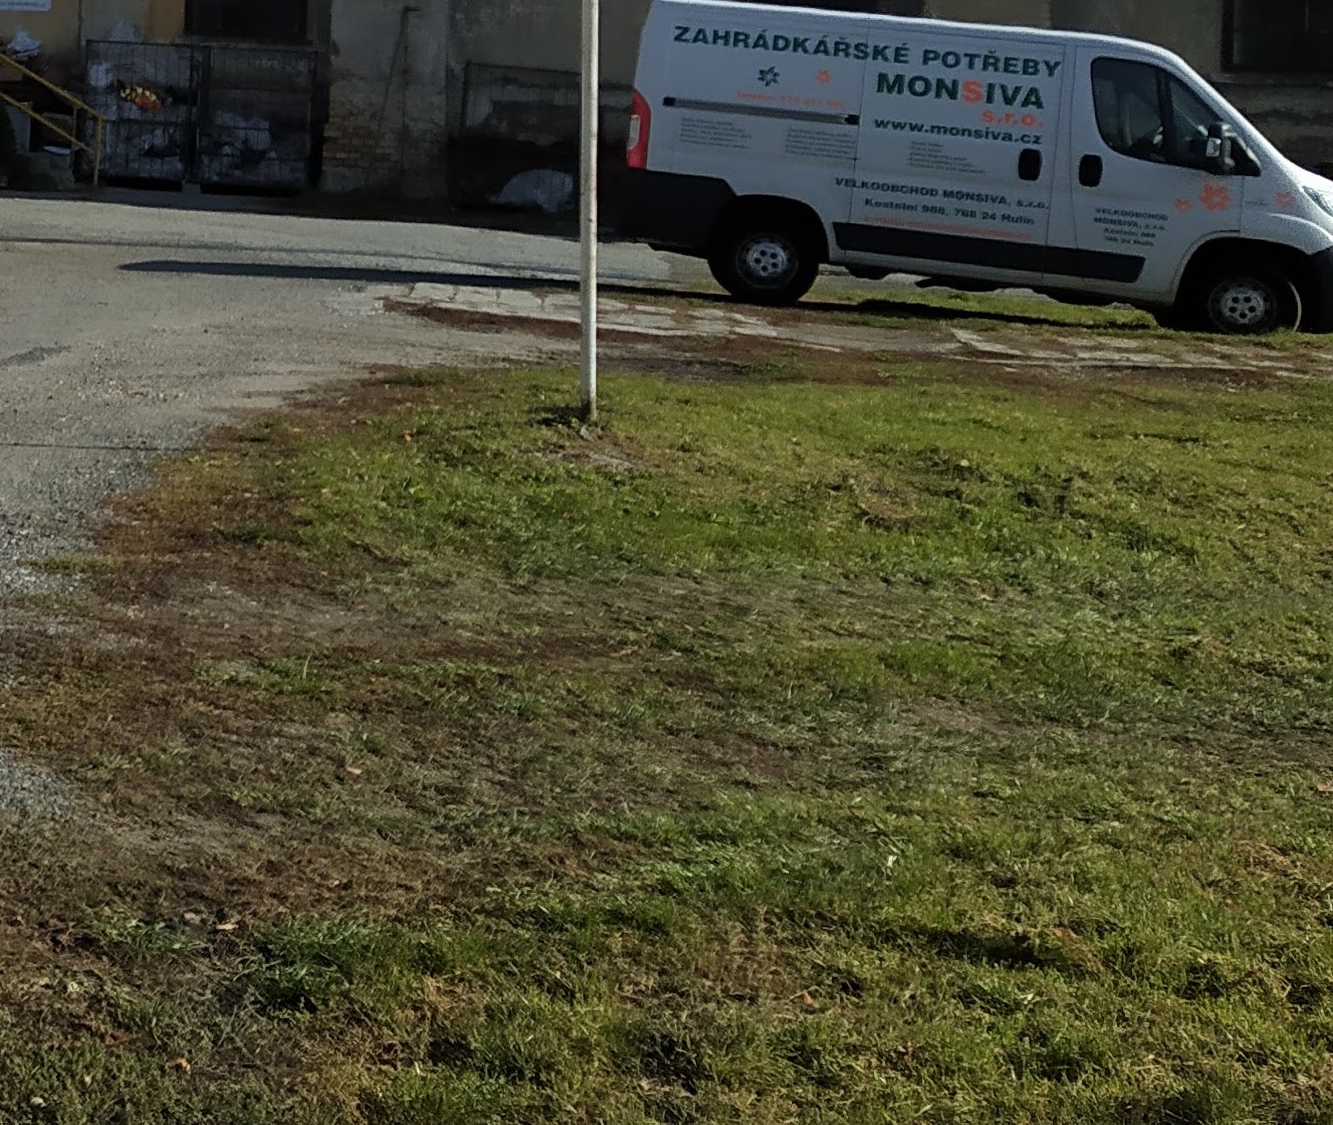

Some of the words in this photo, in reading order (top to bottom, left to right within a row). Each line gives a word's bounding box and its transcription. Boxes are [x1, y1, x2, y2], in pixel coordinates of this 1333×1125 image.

[674, 25, 910, 63] ZAHRÁDKÁŘSKÉ
[922, 48, 1061, 77] POTŘEBY
[876, 72, 1044, 109] MONSIVA
[874, 118, 1043, 144] www.monsiva.cz
[981, 110, 1044, 129] s.r.o.
[835, 178, 938, 196] VELKOOBCHOD
[943, 190, 1012, 207] MONSIVA,
[981, 211, 997, 221] 24
